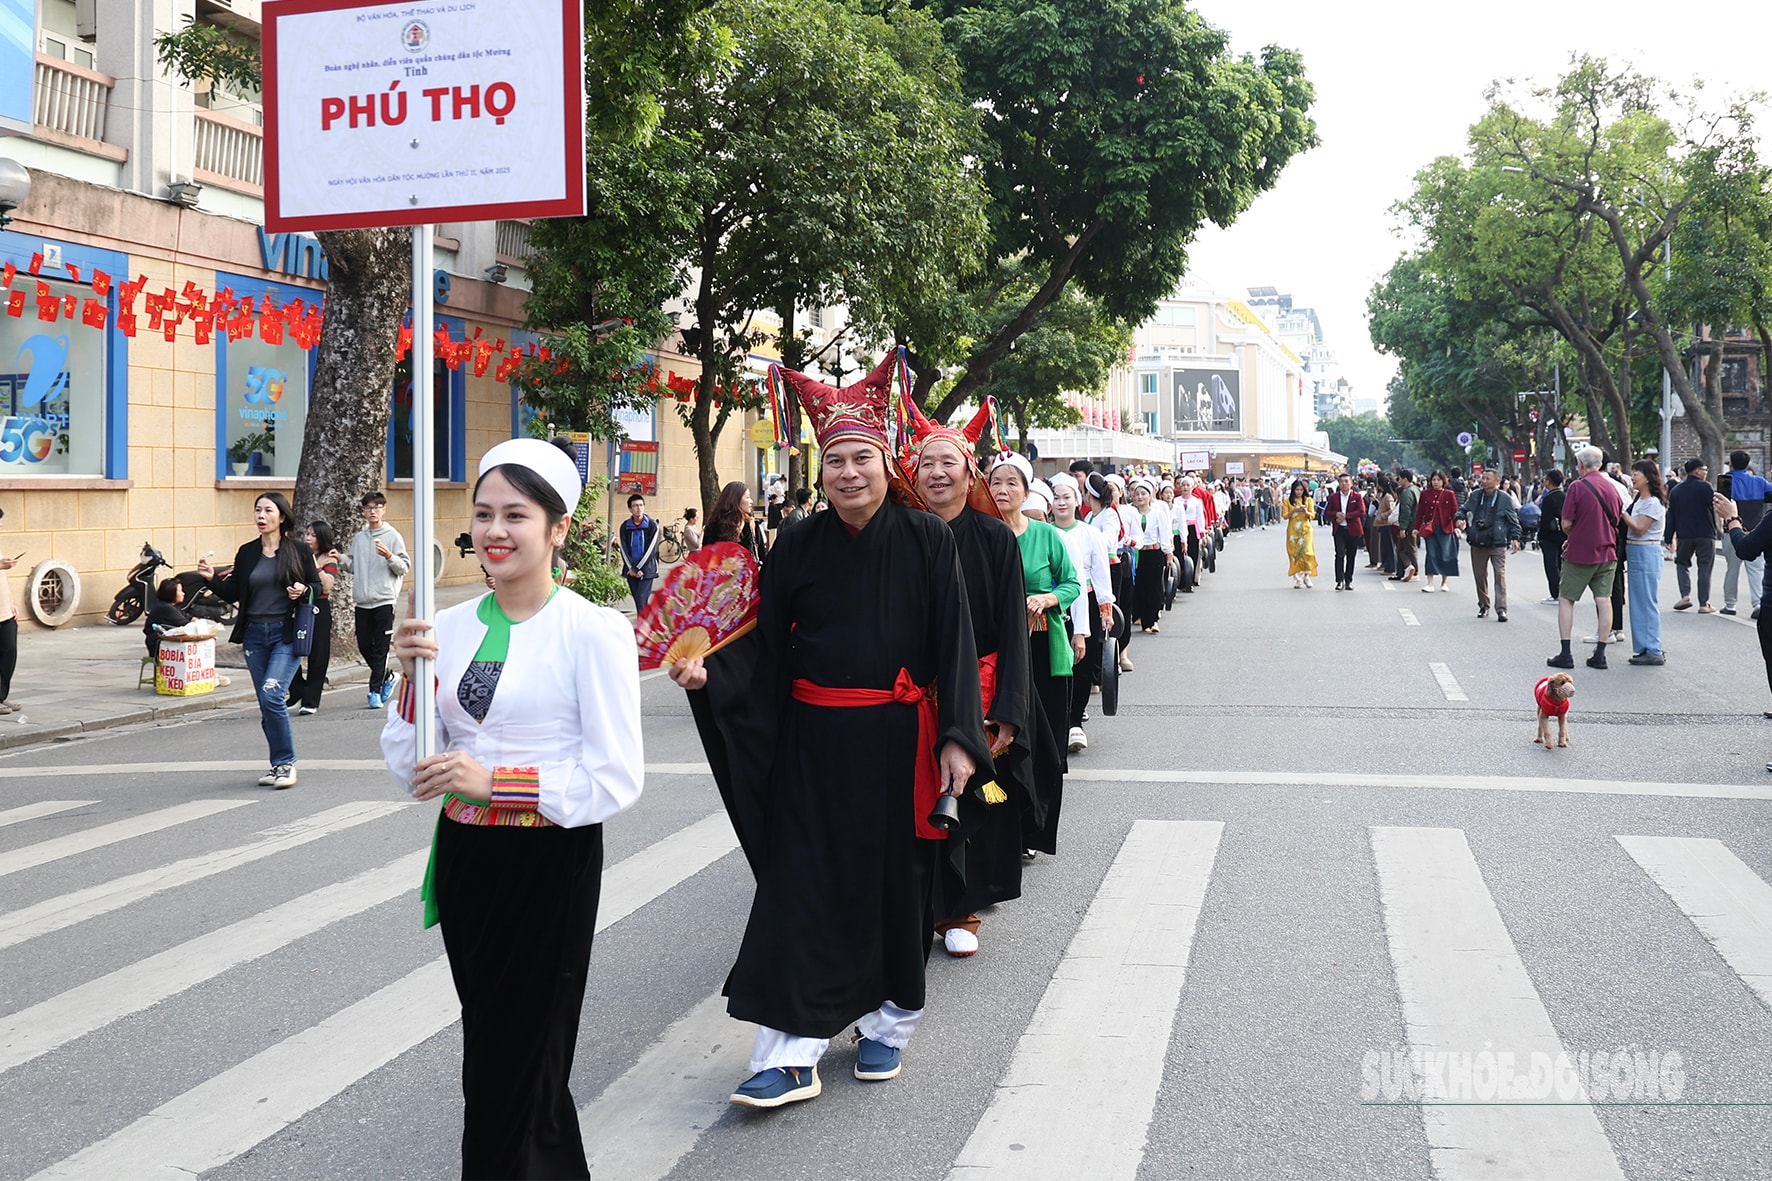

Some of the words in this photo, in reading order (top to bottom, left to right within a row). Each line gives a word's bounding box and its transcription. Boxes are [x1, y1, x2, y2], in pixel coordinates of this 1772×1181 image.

[367, 12, 381, 20] VĂN
[416, 7, 435, 15] THAO
[436, 4, 446, 13] VÀ
[324, 64, 342, 72] Đoàn
[344, 61, 360, 71] nghệ
[382, 57, 397, 66] diễn
[399, 57, 413, 65] viên
[457, 51, 471, 60] dân
[472, 49, 483, 59] tộc
[485, 48, 512, 57] Mường
[321, 80, 408, 131] PHÚ
[422, 81, 516, 126] THỌ
[387, 173, 401, 182] DÂN
[402, 172, 415, 181] TỘC
[480, 166, 494, 175] NĂM
[15, 411, 69, 429] VNPT
